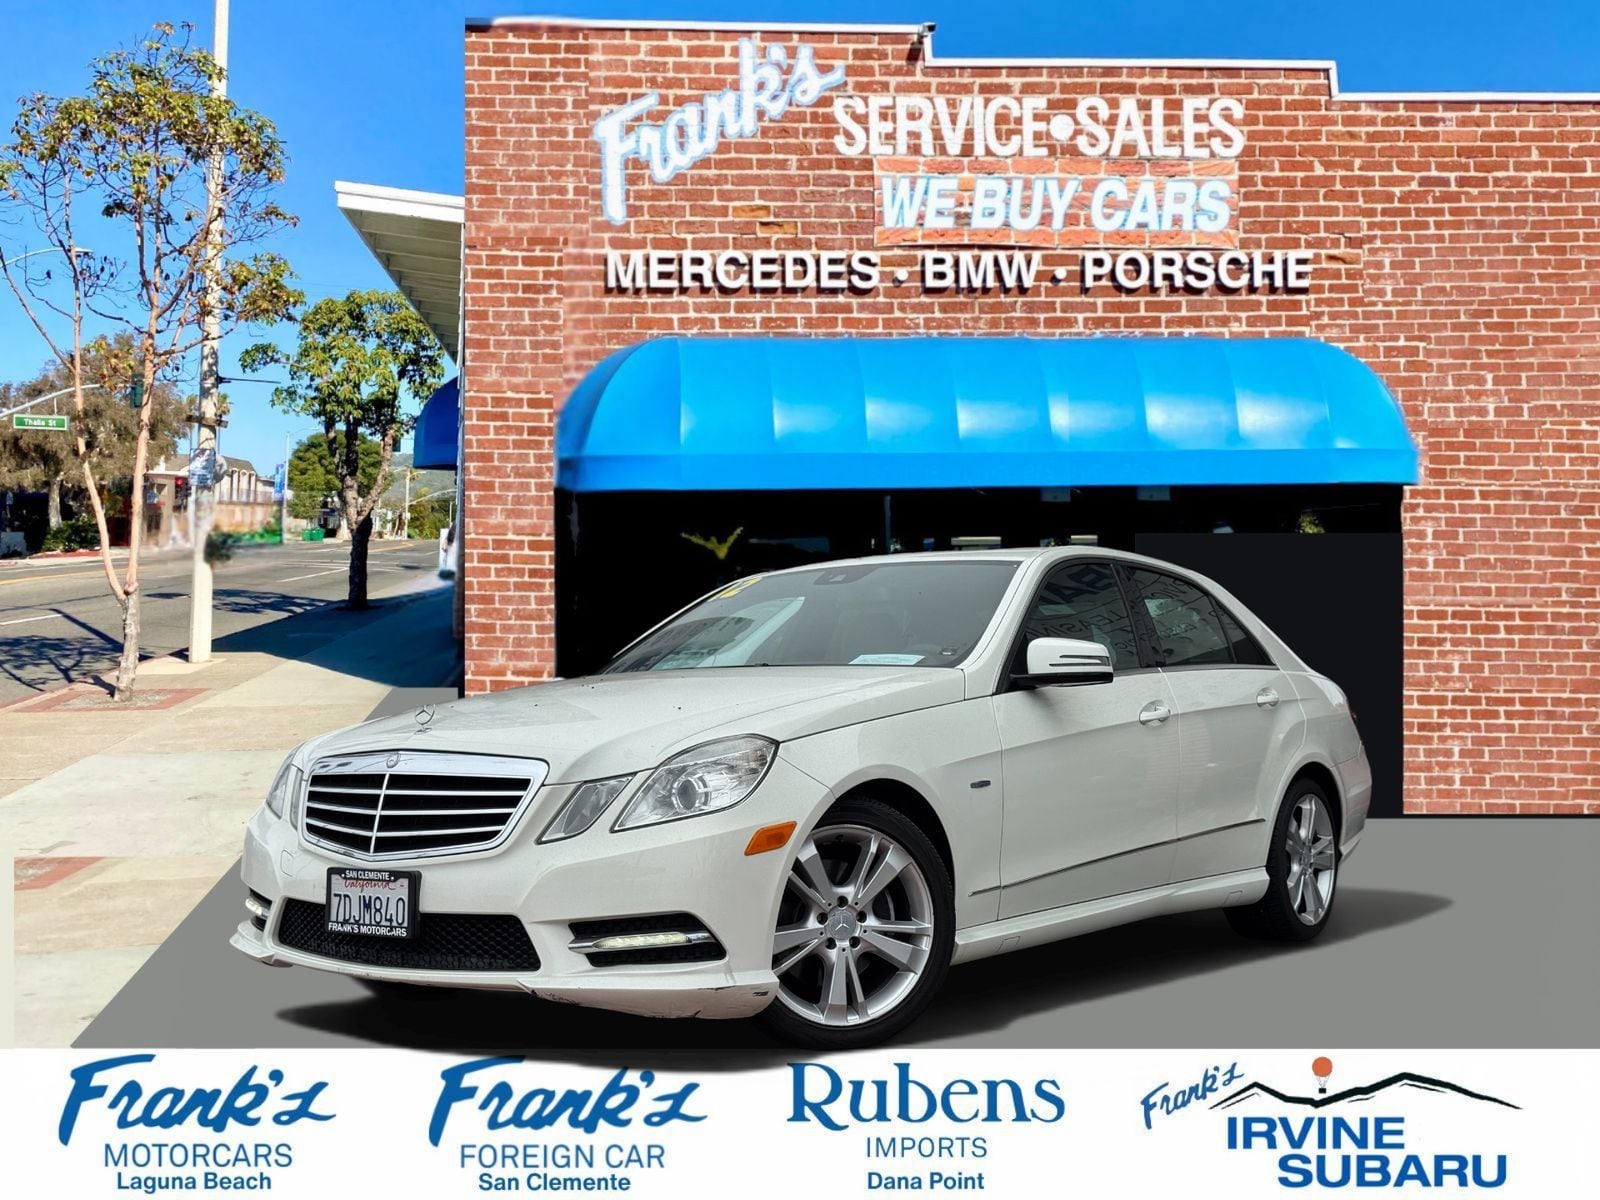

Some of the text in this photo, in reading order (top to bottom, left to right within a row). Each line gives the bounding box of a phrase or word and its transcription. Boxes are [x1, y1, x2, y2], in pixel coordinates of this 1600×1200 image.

[593, 37, 846, 225] Frank's
[833, 95, 1246, 158] SERVICE SALES
[880, 176, 1233, 233] WE BUY CARS
[606, 248, 1313, 291] MERCEDES BMW PORSCHE
[345, 870, 390, 881] SAN CLEMENTE
[328, 922, 407, 937] FRANK'S MOTORCARS
[333, 893, 406, 927] 7DJM840
